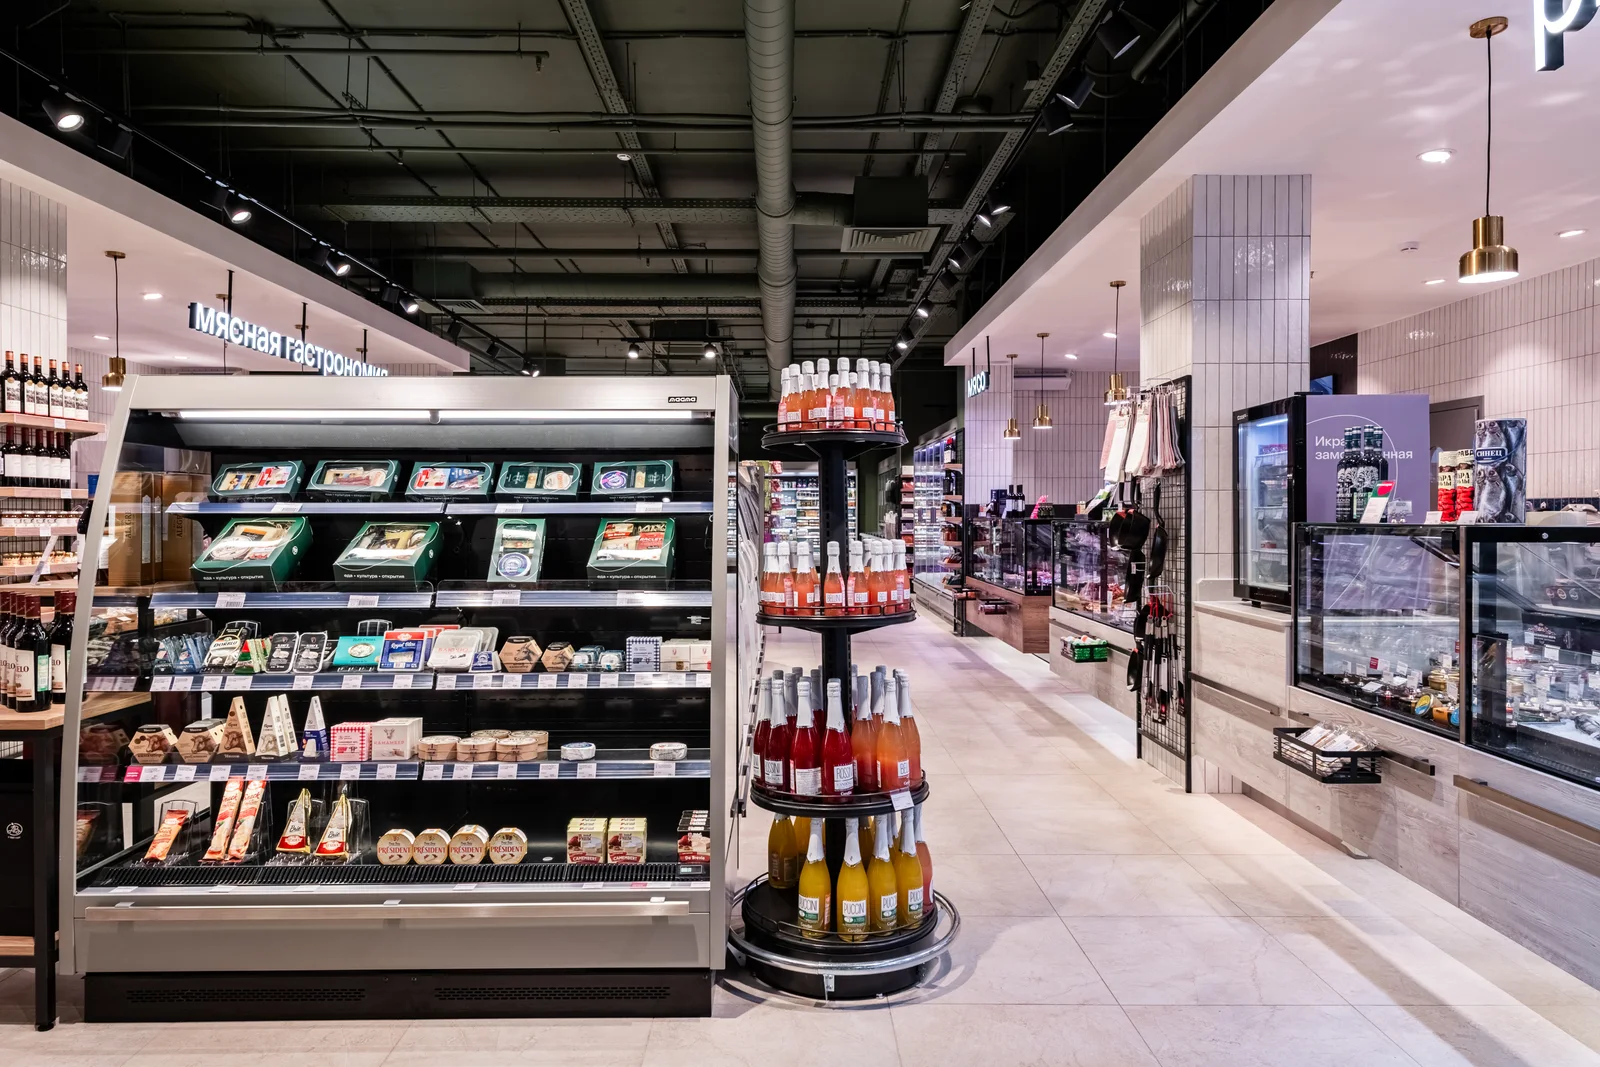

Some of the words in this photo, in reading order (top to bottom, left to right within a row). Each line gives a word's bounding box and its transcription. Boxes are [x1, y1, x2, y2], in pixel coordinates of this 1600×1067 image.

[1315, 450, 1413, 460] замонная
[378, 845, 411, 853] PRÉSIDENT
[413, 845, 446, 853] PRÉSIDENT
[450, 845, 483, 853] PRÉSIDENT
[490, 845, 523, 853] PRÉSIDENT
